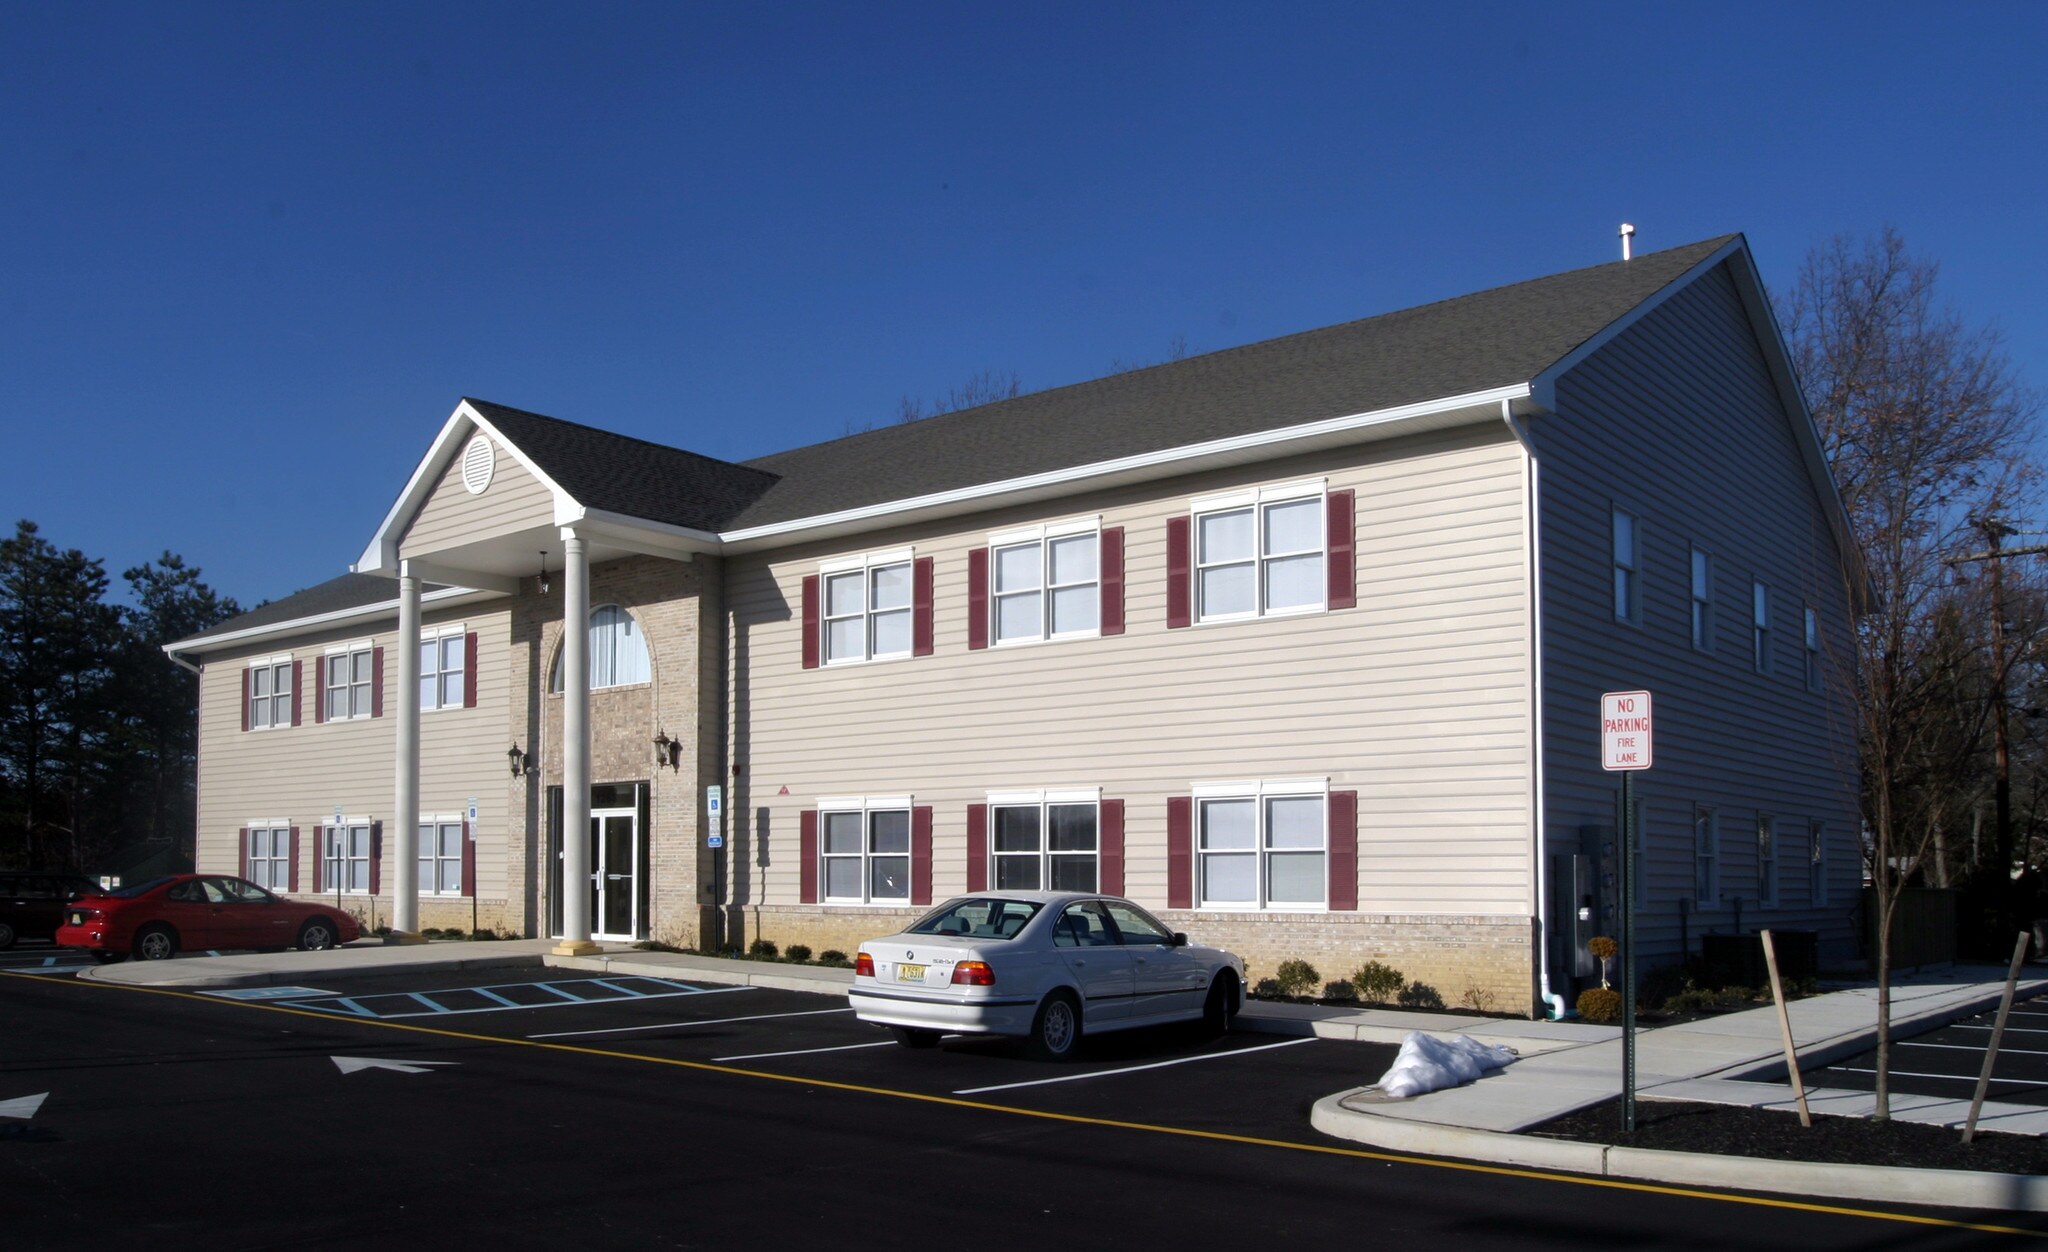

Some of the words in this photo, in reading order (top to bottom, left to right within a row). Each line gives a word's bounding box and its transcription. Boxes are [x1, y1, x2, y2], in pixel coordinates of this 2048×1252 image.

[1618, 698, 1634, 713] NO
[1605, 717, 1648, 733] PARKING
[1617, 737, 1636, 748] FIRE
[1616, 752, 1638, 763] LANE
